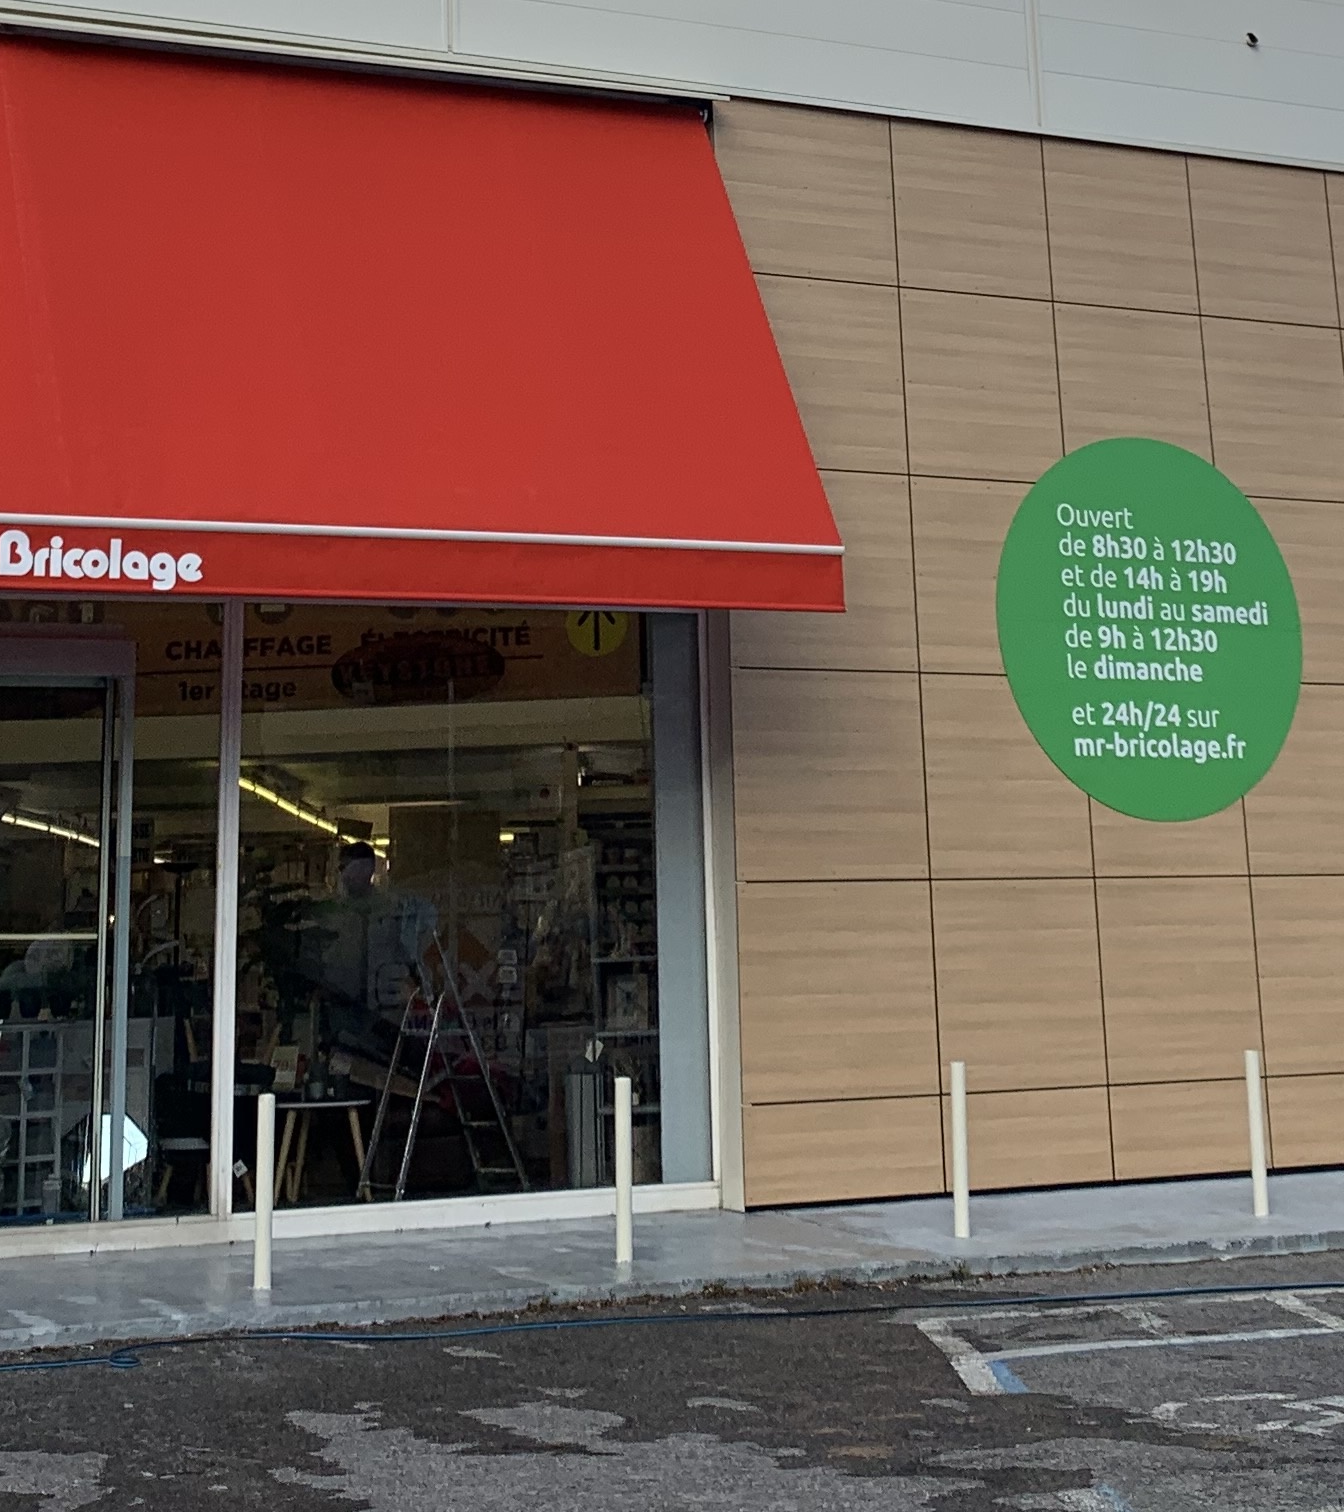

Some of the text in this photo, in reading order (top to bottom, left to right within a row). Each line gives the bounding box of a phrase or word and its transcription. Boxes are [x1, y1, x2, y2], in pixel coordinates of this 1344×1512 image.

[1057, 503, 1134, 529] Ouvert
[1059, 533, 1236, 565] de 8h30 à 12h30
[1061, 564, 1227, 594] et de 14h à 19h
[1064, 594, 1268, 625] du lundi au samedi
[165, 634, 332, 661] CHAFFAGE
[1065, 625, 1218, 653] de 9h à 12h30
[1067, 654, 1203, 683] le dimanche
[179, 679, 297, 703] 1er tage
[1072, 702, 1220, 731] et 24h/24 sur
[1074, 732, 1246, 763] mr-bricolage.fr
